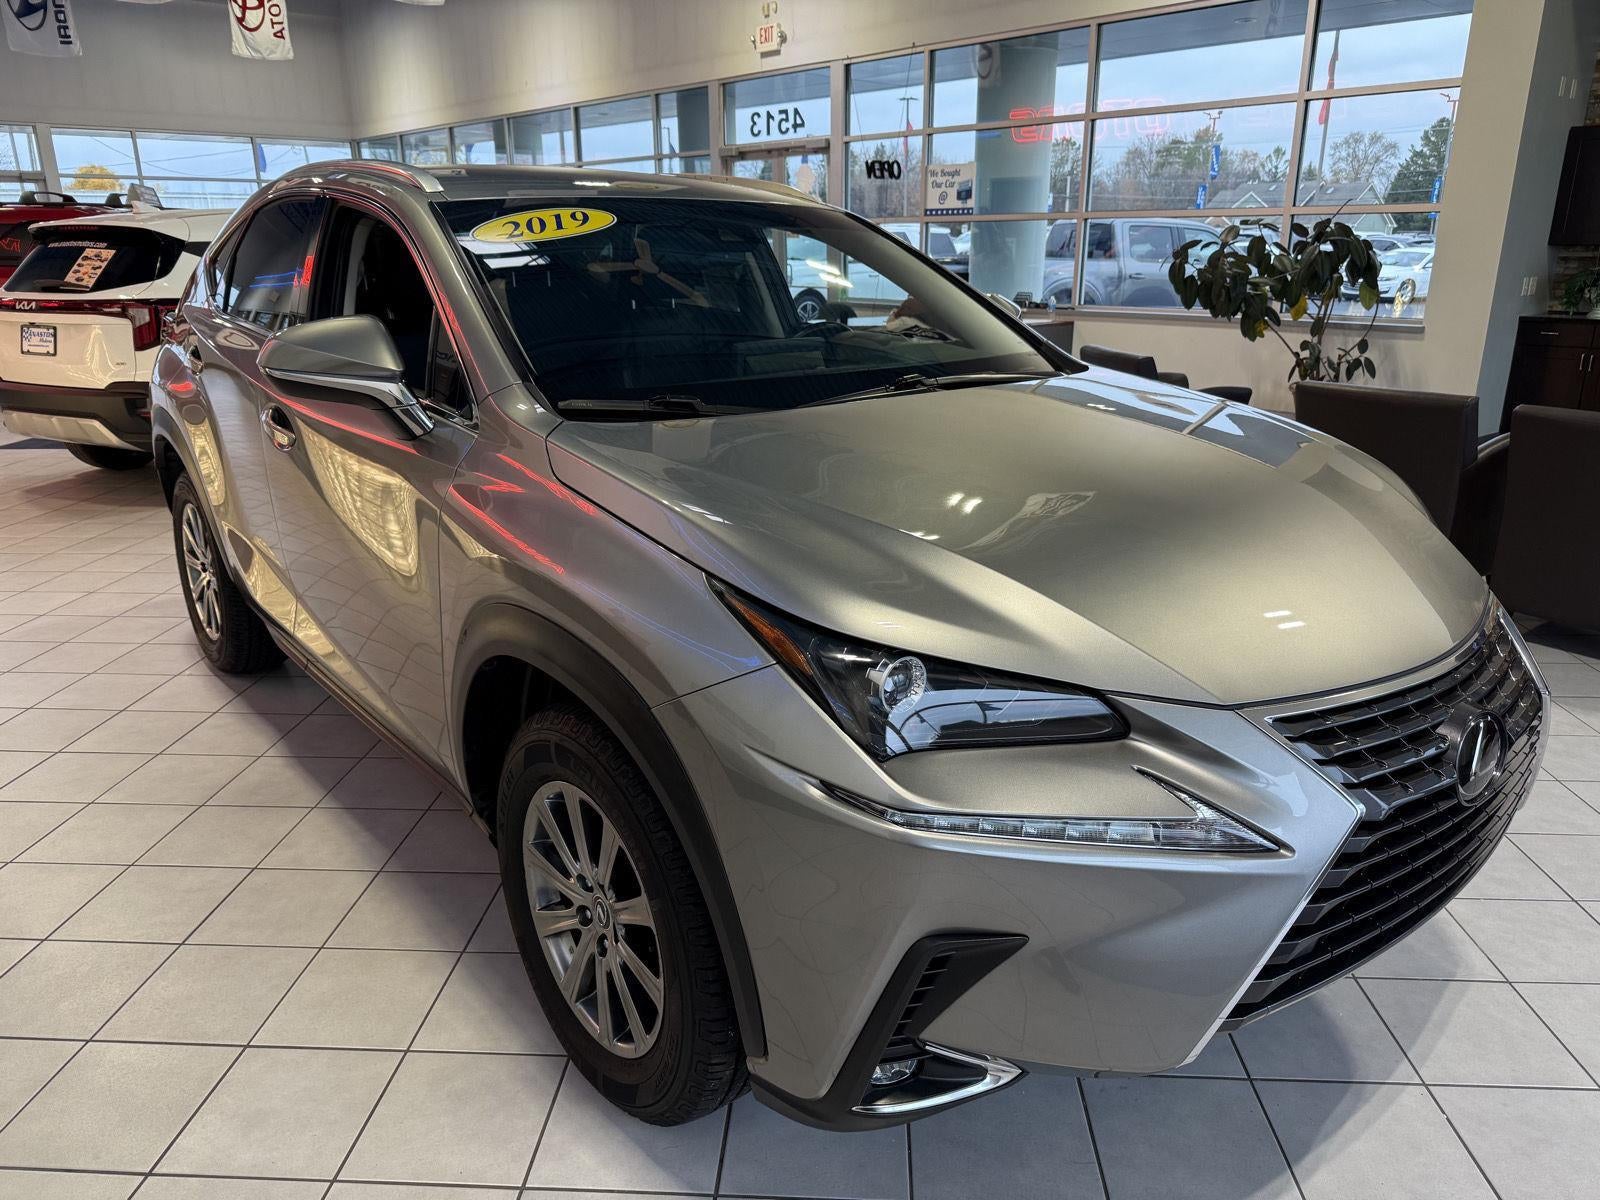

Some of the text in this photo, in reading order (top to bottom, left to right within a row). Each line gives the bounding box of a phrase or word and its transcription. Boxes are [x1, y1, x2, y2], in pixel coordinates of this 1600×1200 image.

[759, 25, 774, 45] EXIT
[929, 168, 961, 179] We Bought
[931, 179, 956, 189] Our Car
[496, 210, 590, 239] 2019
[15, 300, 36, 310] KIA
